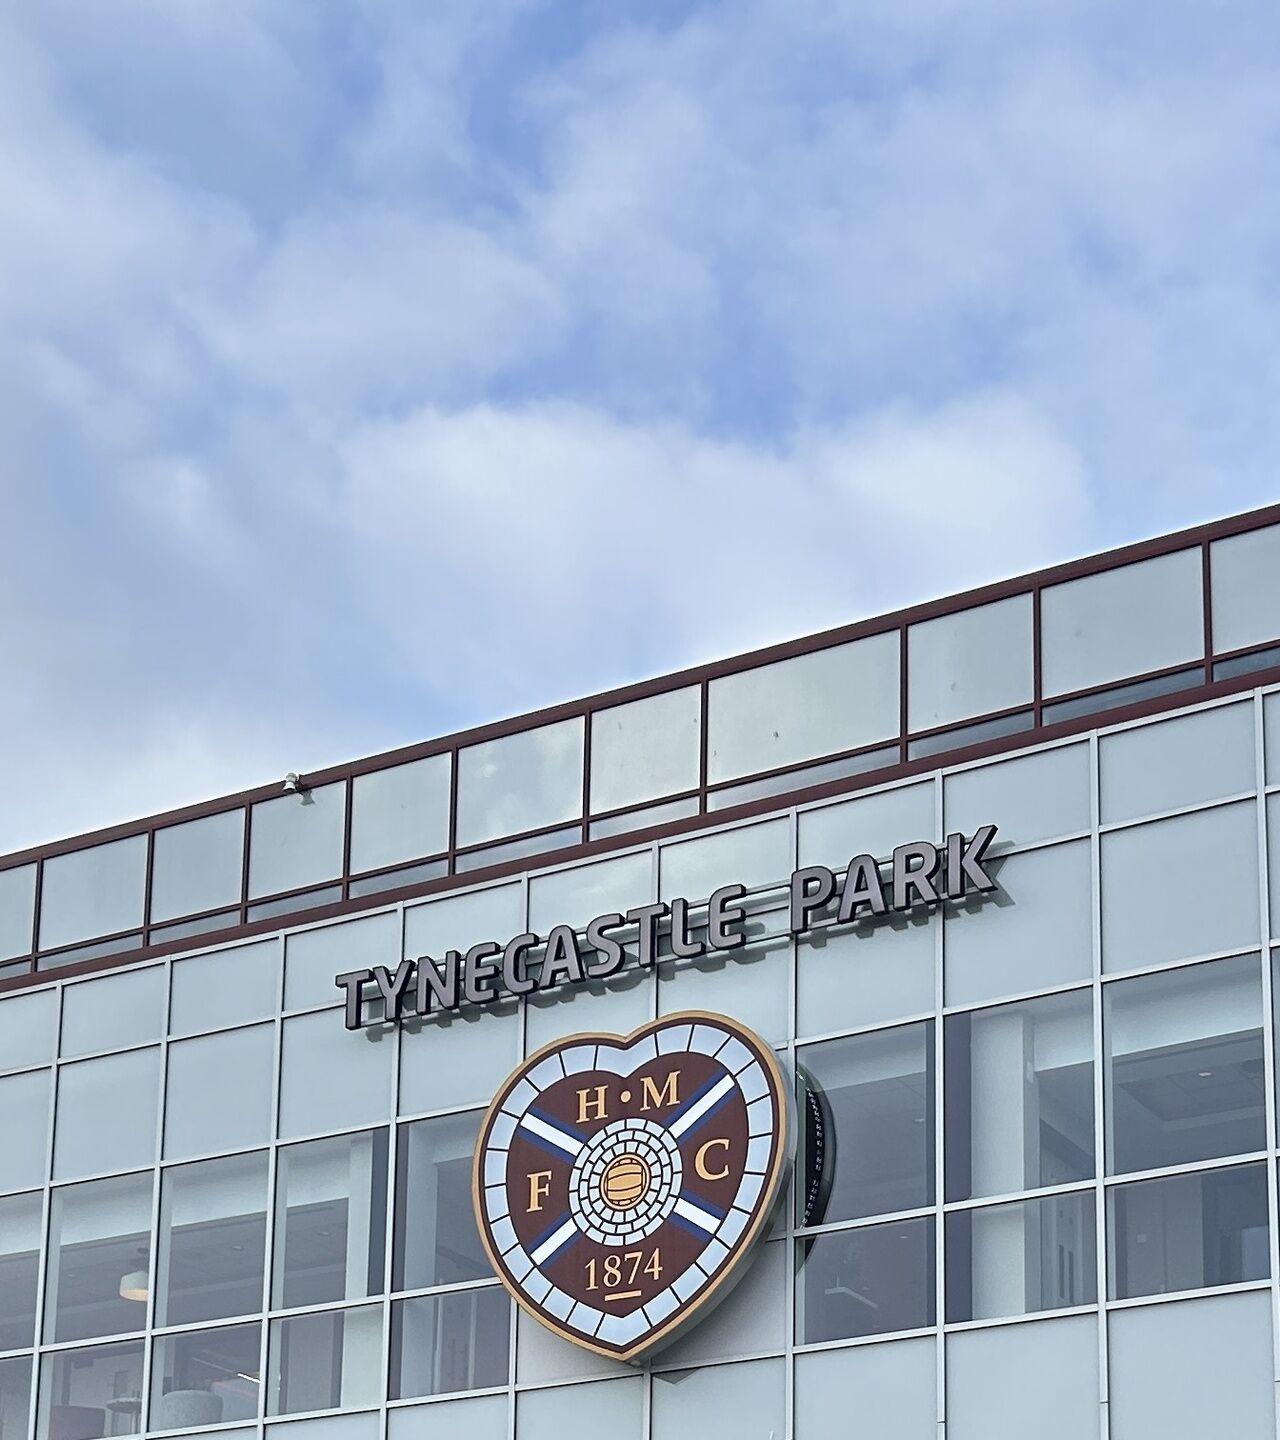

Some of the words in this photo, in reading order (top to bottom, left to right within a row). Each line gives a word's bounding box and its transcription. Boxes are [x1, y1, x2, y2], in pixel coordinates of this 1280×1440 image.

[335, 883, 747, 1031] TYNECASTLE
[789, 823, 999, 935] PARK
[526, 1171, 553, 1212] F
[694, 1138, 731, 1181] C
[583, 1247, 664, 1293] 1874
